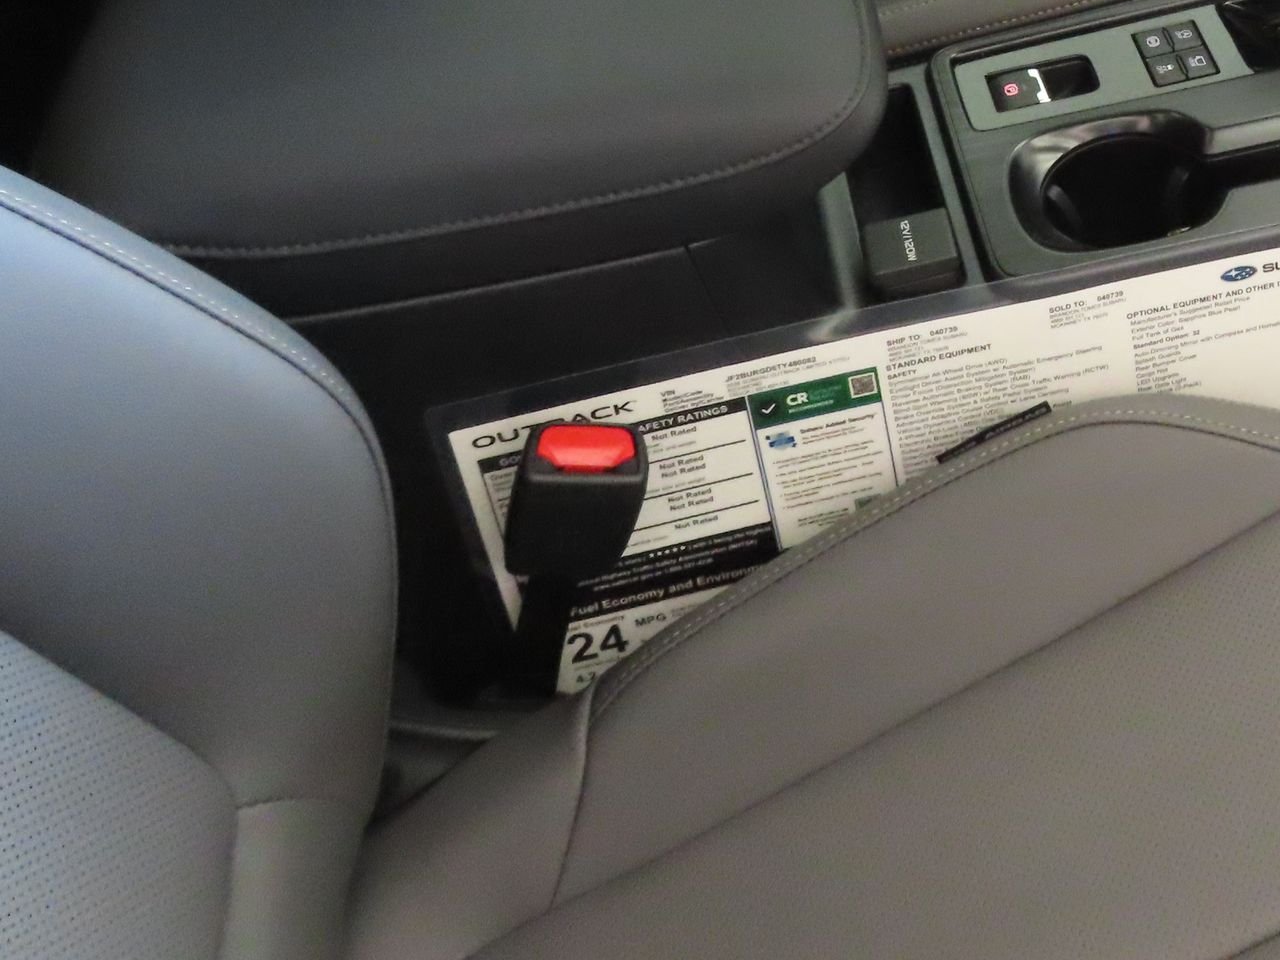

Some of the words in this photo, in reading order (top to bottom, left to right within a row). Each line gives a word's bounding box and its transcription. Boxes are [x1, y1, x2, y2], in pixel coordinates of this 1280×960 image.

[1126, 304, 1170, 320] OPTIONAL
[1172, 292, 1222, 309] EQUIPMENT
[1224, 288, 1243, 298] AND
[1245, 281, 1274, 293] OTHER
[1048, 302, 1072, 314] SOLD
[886, 336, 906, 347] SHIP
[886, 355, 937, 371] STANDARD
[938, 343, 992, 361] EQUIPMENT
[888, 369, 917, 381] SAFETY
[660, 389, 675, 397] VIN
[784, 390, 809, 406] CR
[637, 417, 674, 432] AFETY
[676, 404, 729, 423] RATINGS
[669, 425, 697, 437] Rated
[676, 454, 704, 466] Rated
[679, 462, 706, 474] Rated
[685, 487, 712, 499] Rated
[687, 495, 714, 507] Rated
[692, 514, 719, 526] Rated
[568, 601, 599, 617] Fuel
[601, 587, 665, 609] Economy
[667, 578, 693, 592] and
[567, 625, 629, 662] 24
[633, 612, 667, 626] MPG
